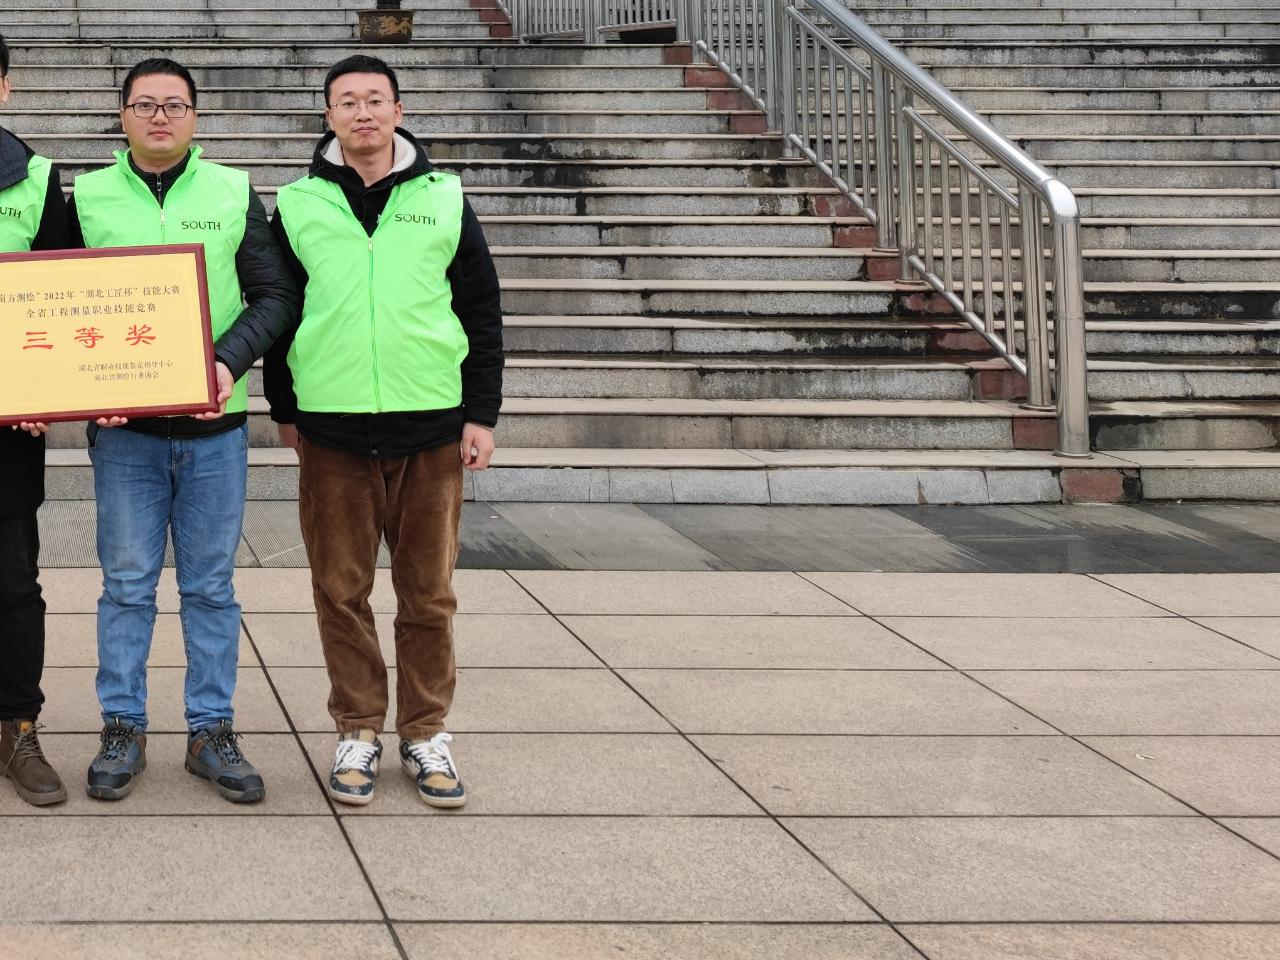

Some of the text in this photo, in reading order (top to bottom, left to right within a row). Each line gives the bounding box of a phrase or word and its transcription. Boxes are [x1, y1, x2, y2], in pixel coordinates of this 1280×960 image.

[181, 220, 221, 231] SOUTH
[394, 213, 436, 226] SOUTH
[22, 324, 156, 350] 三等奖
